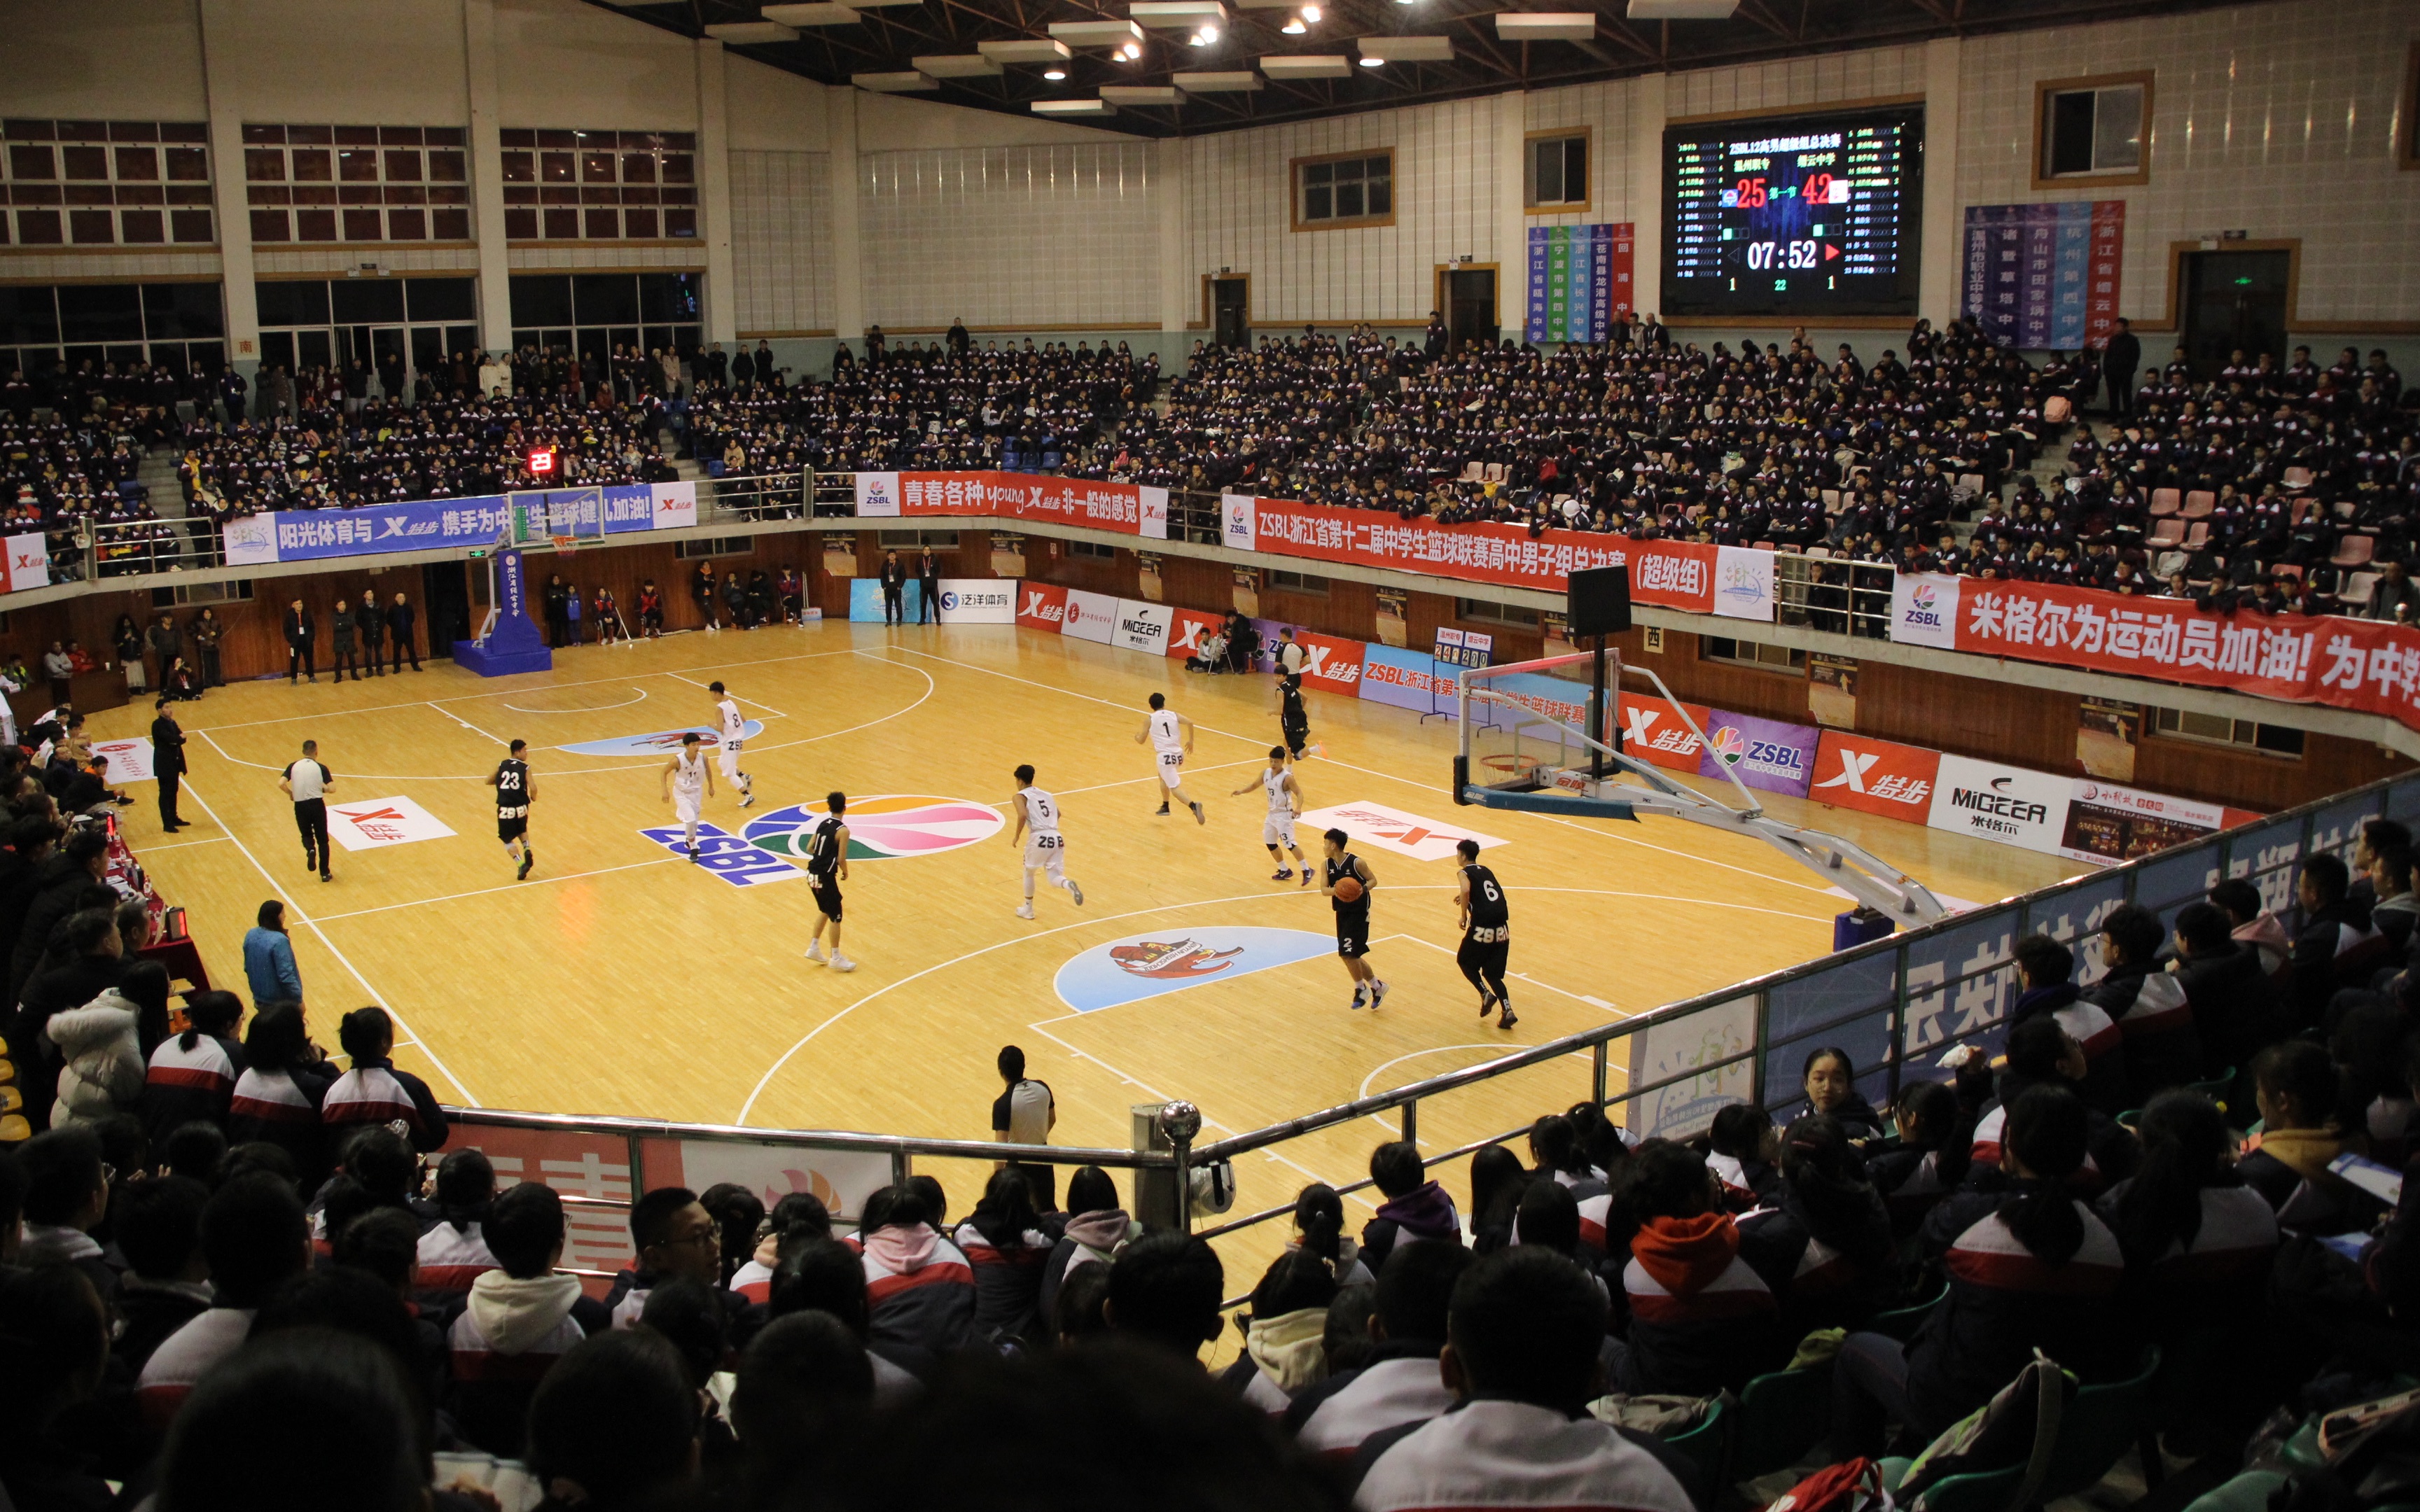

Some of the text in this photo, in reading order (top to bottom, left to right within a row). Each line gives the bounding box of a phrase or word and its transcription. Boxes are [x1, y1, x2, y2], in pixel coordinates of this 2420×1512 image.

[1797, 152, 1836, 168] 缙云中学
[1737, 178, 1766, 208] 25
[1769, 186, 1797, 200] 第一节
[1802, 173, 1833, 204] 42
[1748, 240, 1817, 270] 07:52
[1553, 246, 1564, 340] 宁波市第四中学
[1573, 244, 1585, 340] 浙江省长兴中学
[1594, 244, 1607, 342] 苍南县龙港高级中学
[1729, 278, 1736, 290] 1
[1775, 279, 1786, 290] 22
[1828, 276, 1835, 289] 1
[905, 480, 984, 507] 青春各种
[987, 485, 1024, 514] young
[1062, 487, 1138, 524] 非一般的感觉
[279, 519, 372, 548] 阳光体育与
[1230, 524, 1249, 536] ZSBL
[1636, 555, 1708, 597] (超级组)
[961, 594, 1008, 606] 泛洋体育
[1905, 610, 1941, 626] ZSBL
[1468, 635, 1489, 646] 缙云中学
[1647, 626, 1661, 648] 西
[1969, 592, 2315, 682] 米格尔为运动员加油!
[1323, 661, 1361, 683] 特步
[733, 713, 741, 728] 8
[1162, 722, 1171, 737] 1
[1648, 728, 1702, 755] 特步
[1746, 740, 1803, 770] ZSBL
[500, 771, 520, 790] 23
[1866, 774, 1931, 804] 特步
[1038, 799, 1050, 818] 5
[1970, 814, 2019, 836] 米格尔
[1483, 880, 1499, 902] 6
[1343, 938, 1352, 948] 2
